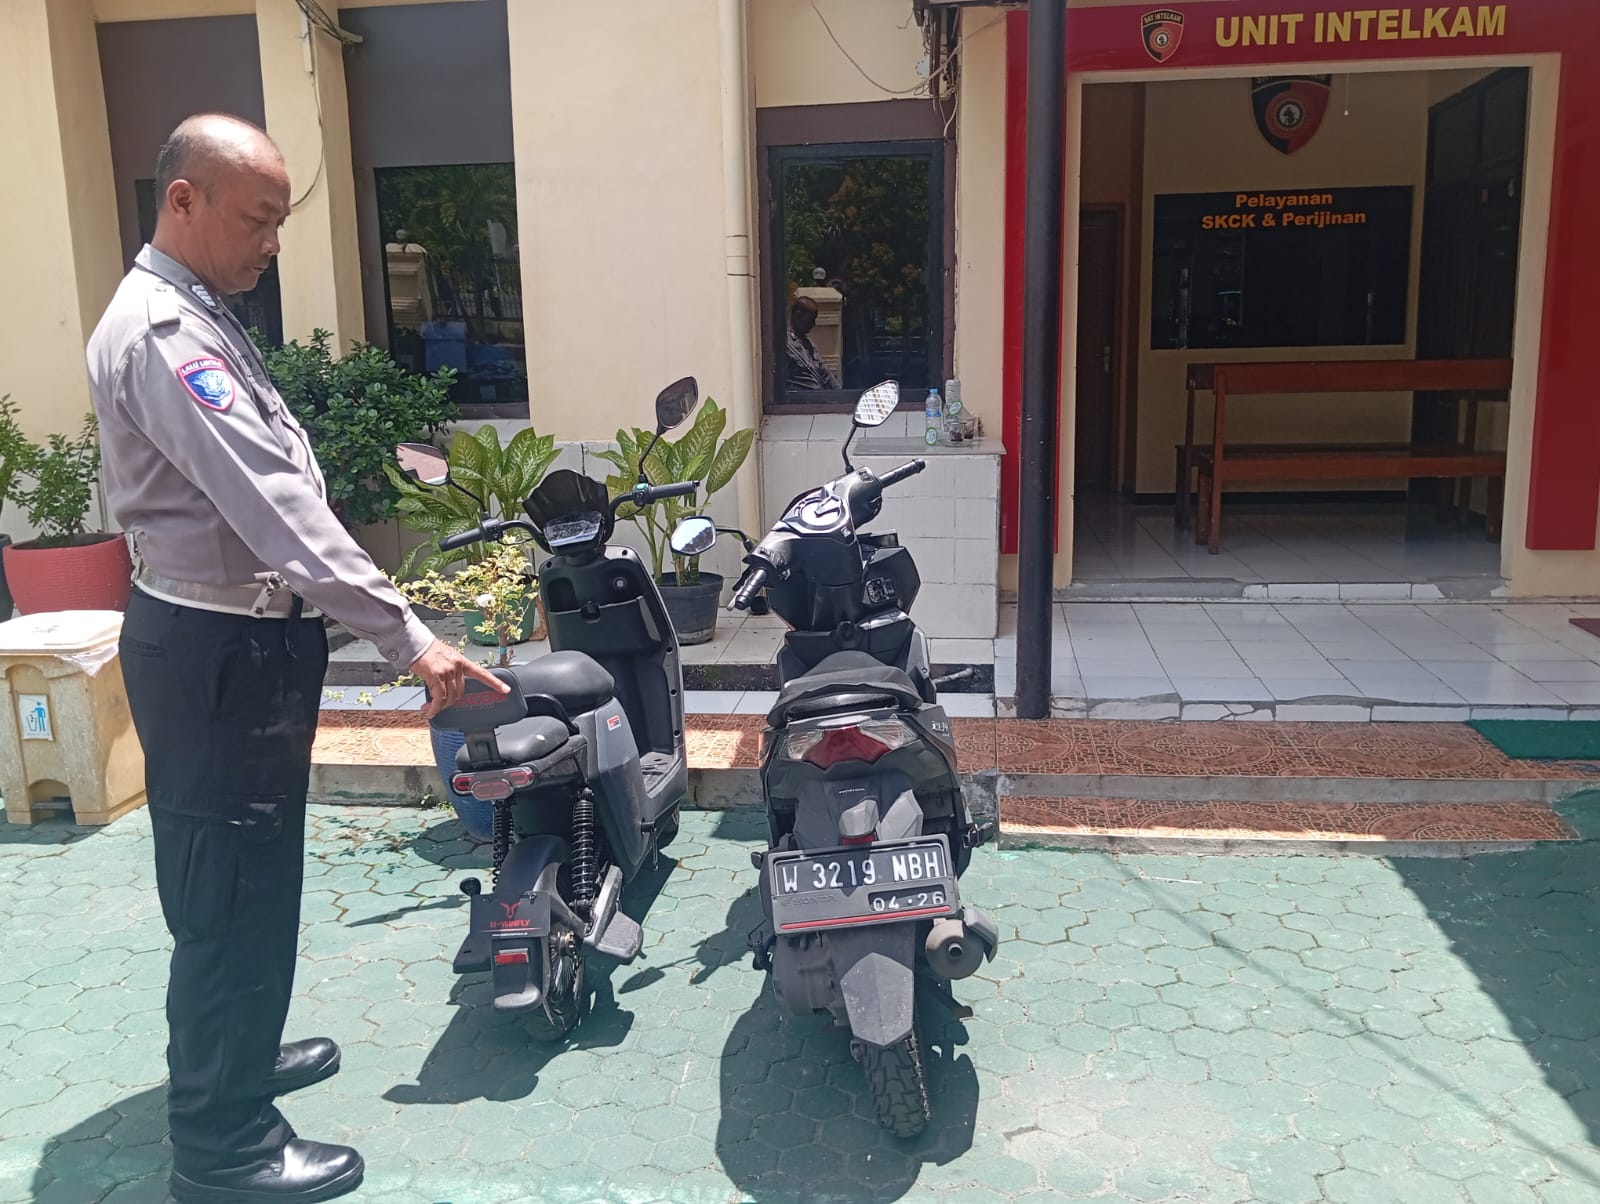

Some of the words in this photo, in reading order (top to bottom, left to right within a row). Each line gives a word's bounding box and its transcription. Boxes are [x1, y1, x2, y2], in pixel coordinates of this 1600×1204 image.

[1216, 14, 1304, 47] UNIT
[1314, 5, 1506, 42] INTELKAM
[1235, 193, 1333, 209] Pelayanan
[1202, 214, 1256, 229] SKCK
[1262, 213, 1276, 227] &
[1282, 211, 1367, 228] Perijinan
[181, 361, 199, 374] LALU
[782, 866, 798, 893] W
[812, 860, 876, 890] 3219
[892, 851, 940, 882] NBH
